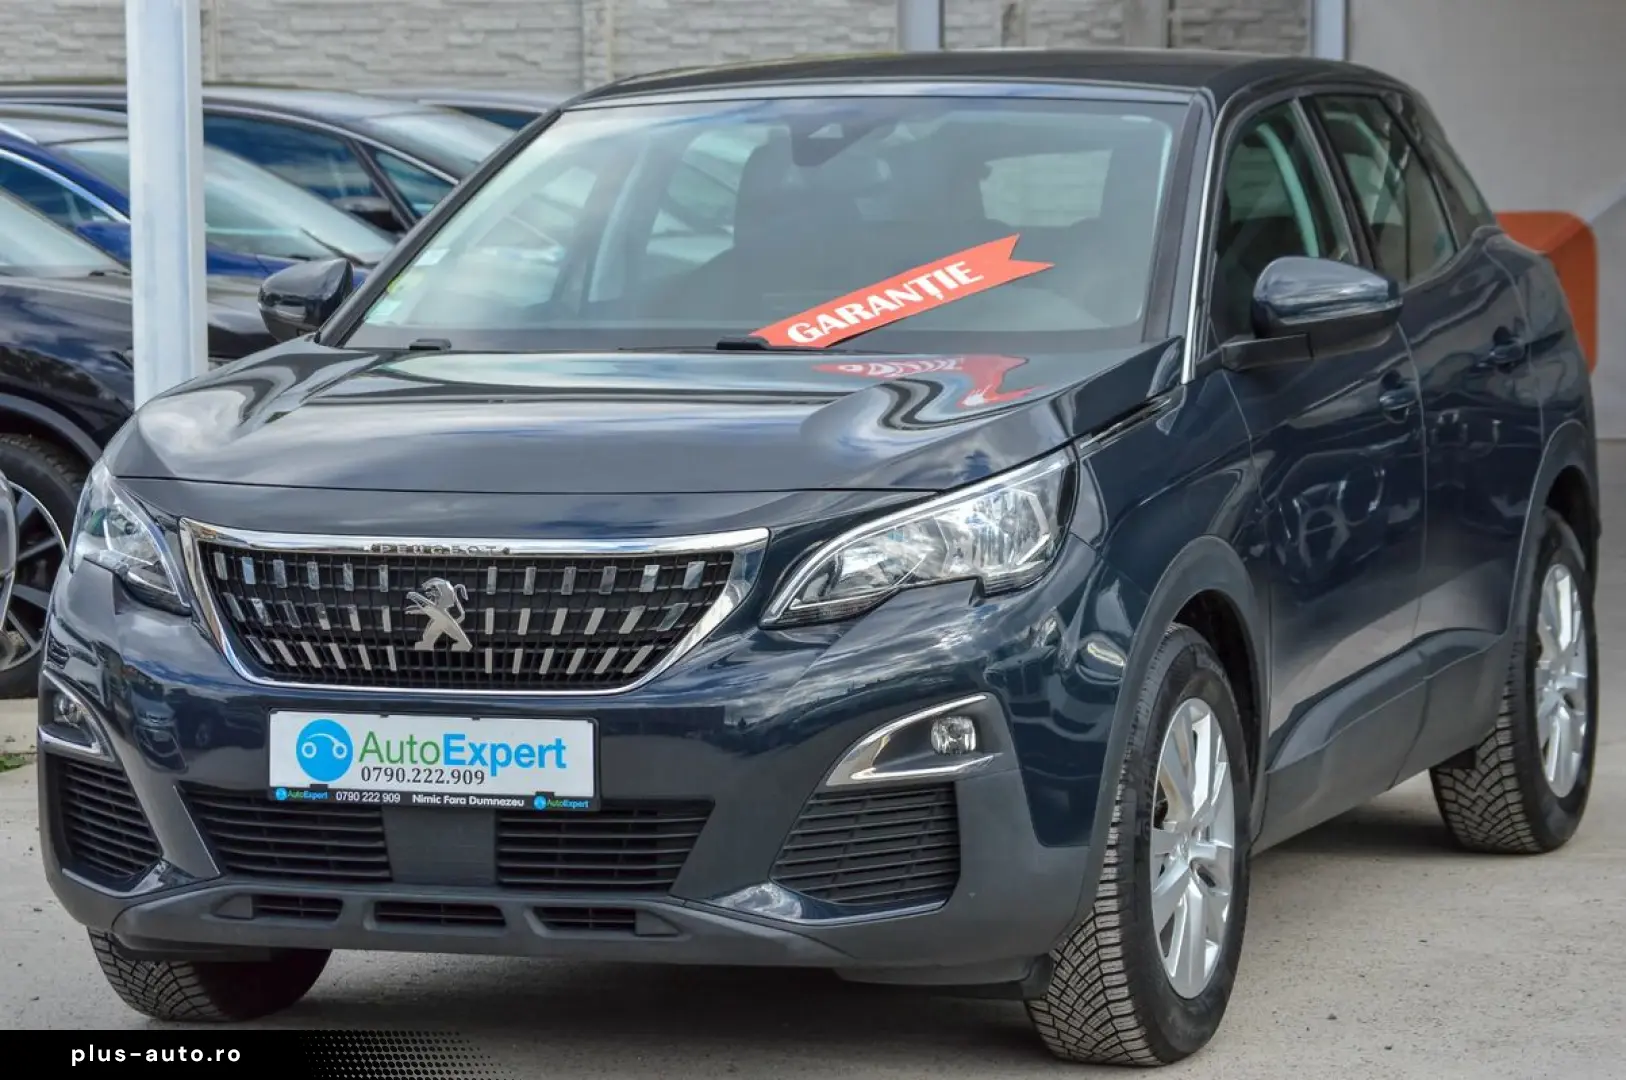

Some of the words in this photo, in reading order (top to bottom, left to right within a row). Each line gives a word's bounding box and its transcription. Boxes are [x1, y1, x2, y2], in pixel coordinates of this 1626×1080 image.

[787, 260, 984, 343] GARANȚIE
[379, 543, 497, 555] PEUGEOT
[358, 730, 567, 777] AutoExpert
[361, 766, 485, 785] 0790.222.909
[287, 790, 328, 800] AutoExpert
[336, 791, 360, 801] 0790
[362, 792, 380, 802] 222
[382, 793, 401, 803] 909
[412, 794, 441, 804] Nimic
[444, 795, 466, 805] Fara
[469, 796, 524, 807] Dumnezeu
[547, 799, 589, 809] AutoExpert
